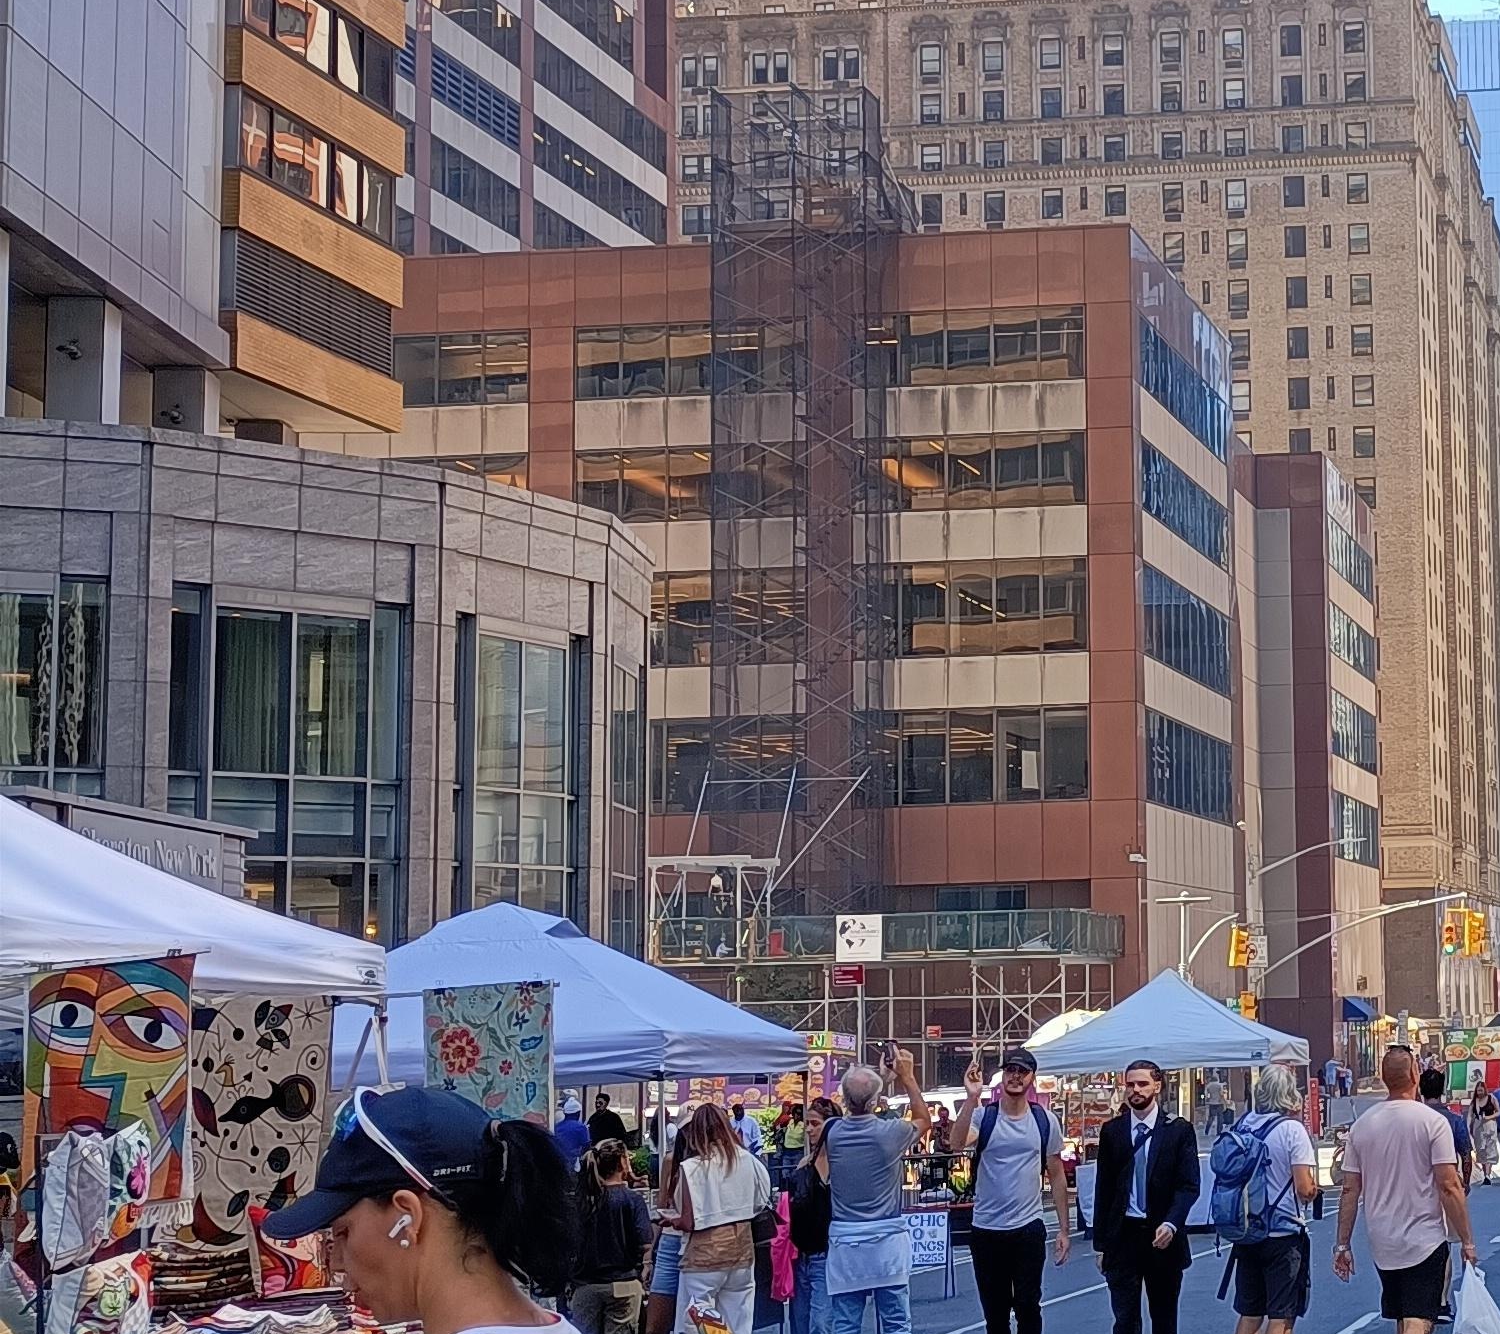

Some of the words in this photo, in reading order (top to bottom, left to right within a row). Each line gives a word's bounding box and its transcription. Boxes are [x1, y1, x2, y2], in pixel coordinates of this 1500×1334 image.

[154, 840, 185, 873] New
[186, 845, 217, 879] York
[433, 1165, 471, 1176] DRI-FIT
[906, 1215, 946, 1227] CHIC
[912, 1240, 945, 1252] INGS
